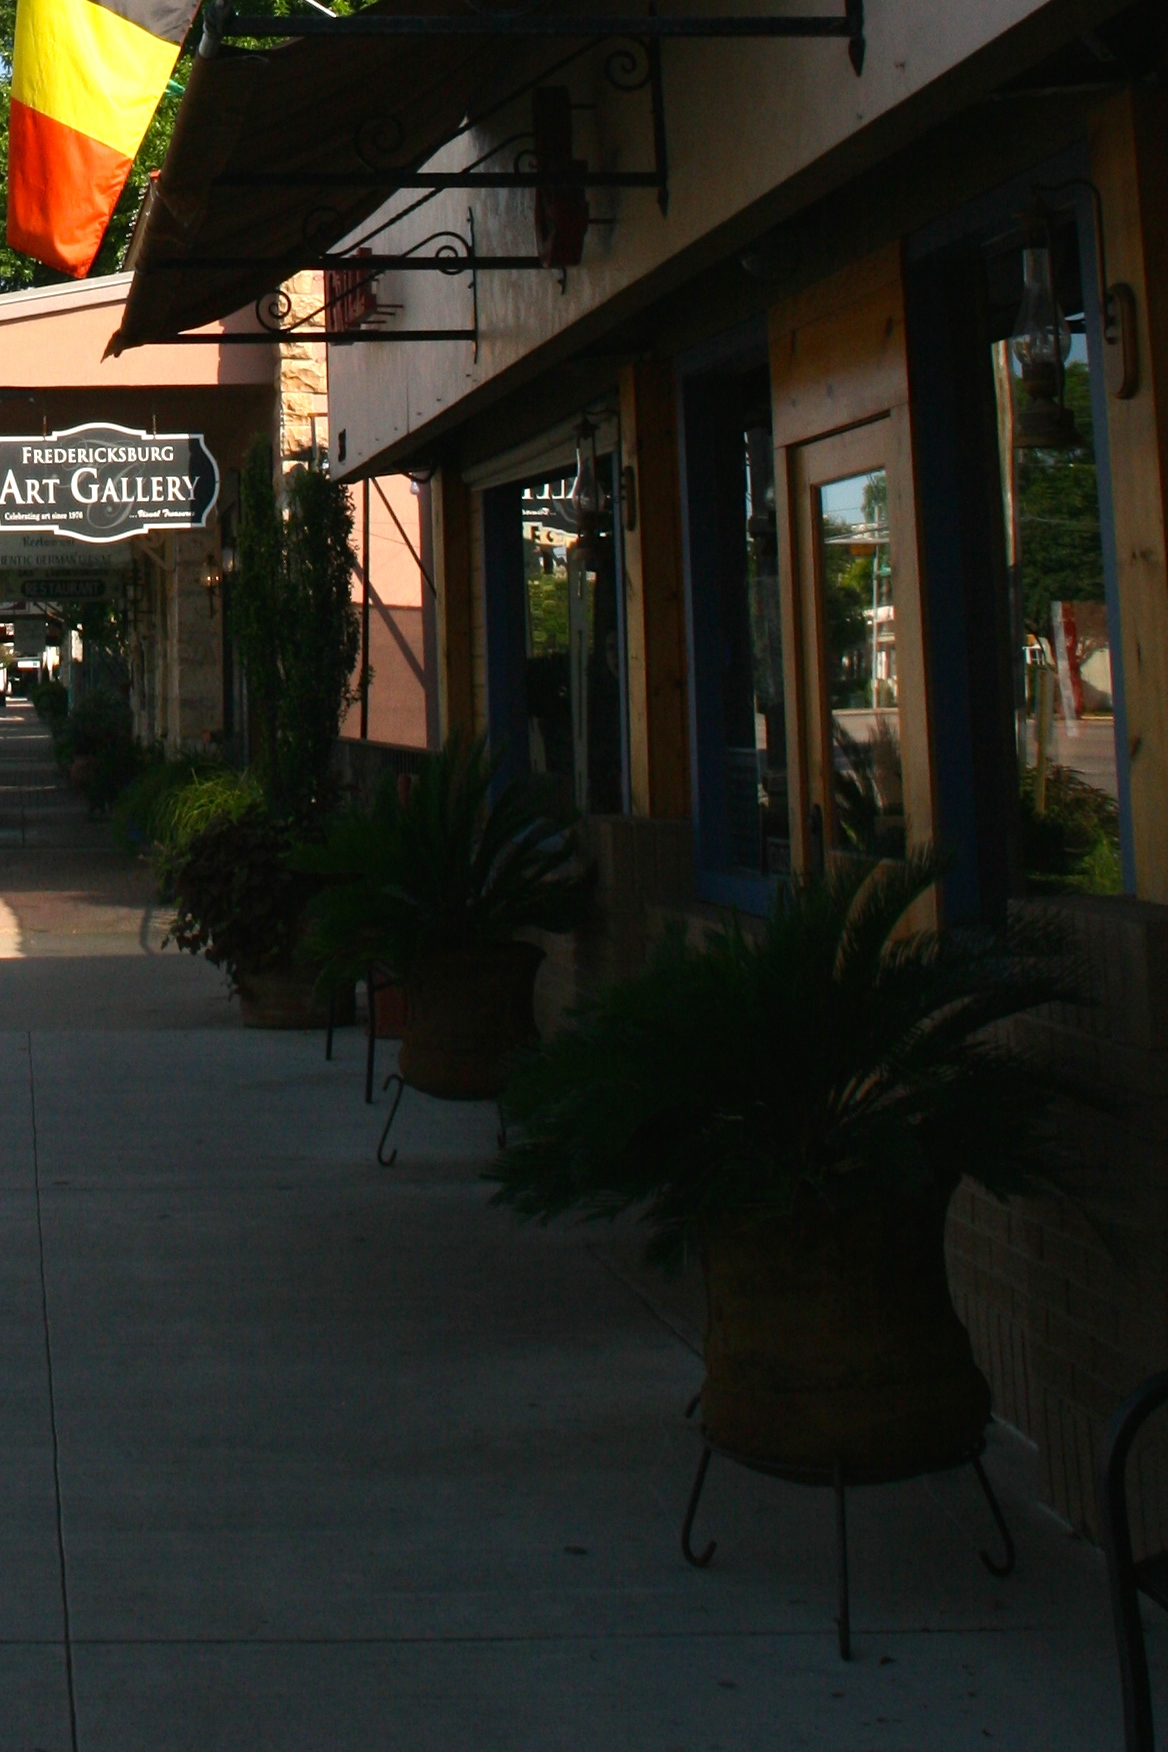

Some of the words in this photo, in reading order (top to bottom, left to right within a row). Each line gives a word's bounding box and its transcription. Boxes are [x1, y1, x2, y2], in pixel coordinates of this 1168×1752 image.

[22, 445, 174, 465] FREDERICKSBURG
[70, 466, 200, 505] GALLERY
[4, 511, 40, 522] Celebrating
[41, 512, 51, 520] art
[51, 511, 67, 520] since
[36, 555, 76, 566] GERMAN
[25, 582, 99, 596] RESTAURANT
